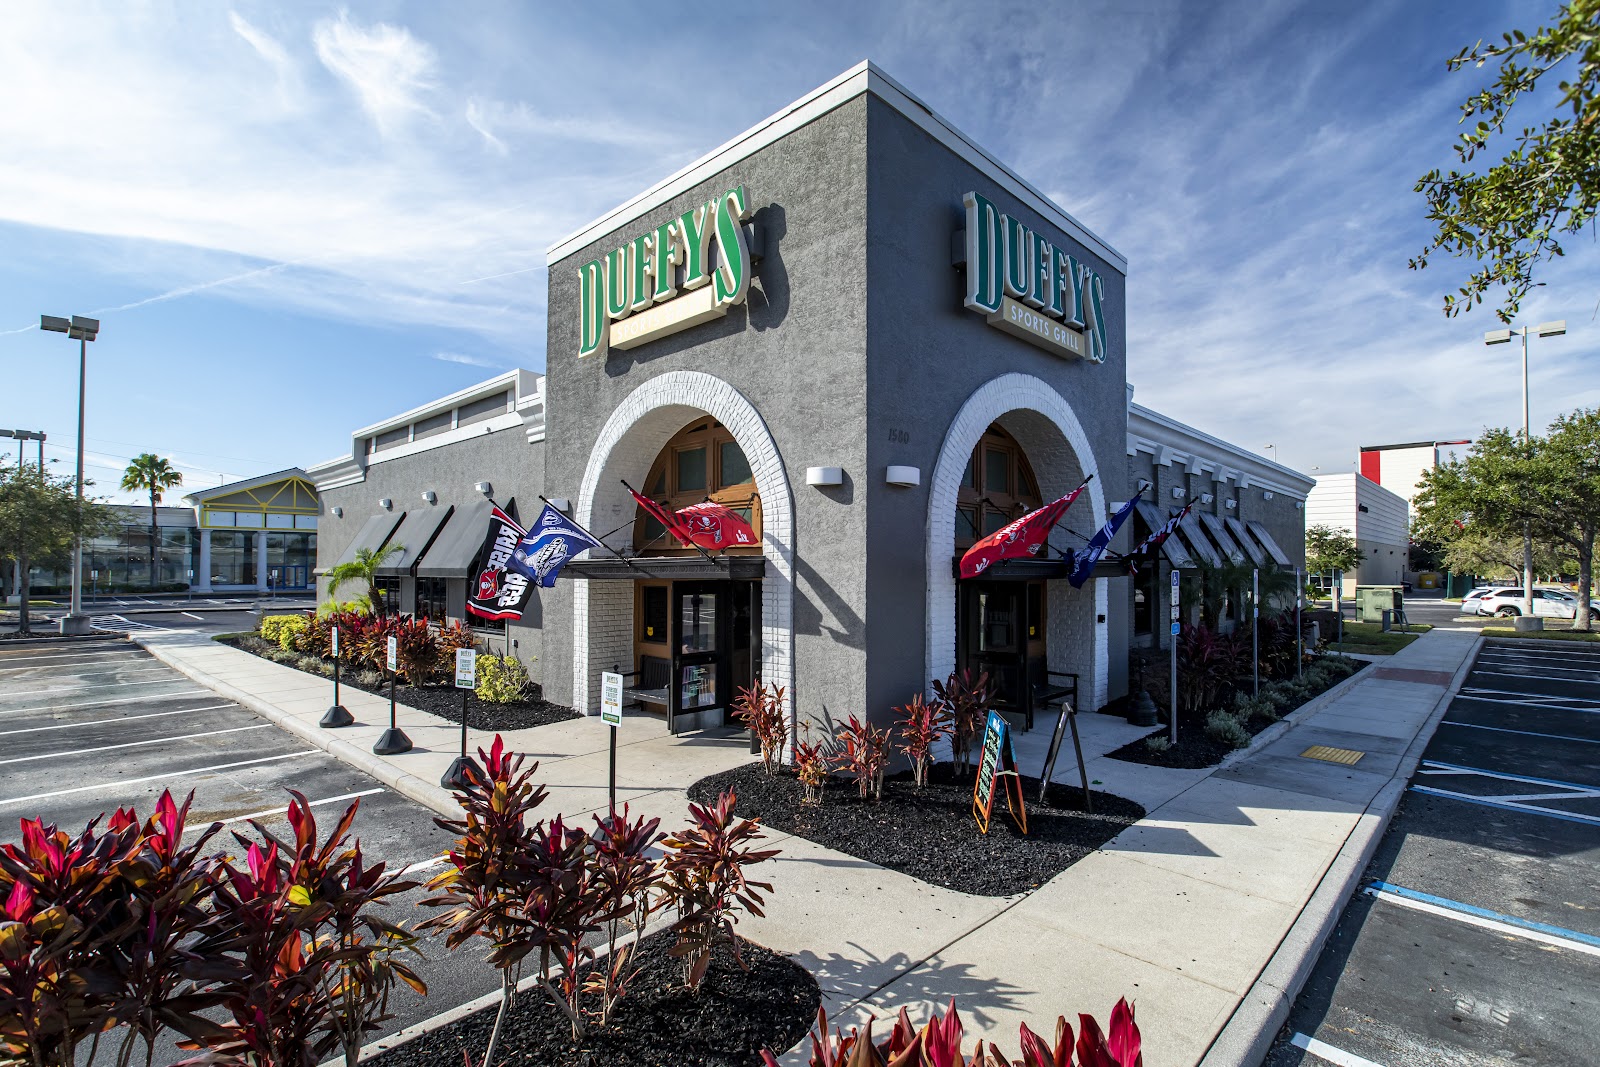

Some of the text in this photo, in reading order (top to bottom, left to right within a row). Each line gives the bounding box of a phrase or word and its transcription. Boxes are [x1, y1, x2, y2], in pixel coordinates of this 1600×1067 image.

[578, 184, 750, 358] DUFFY'S
[963, 191, 1107, 364] DUFFY'S
[617, 311, 660, 341] SPORTS
[1011, 305, 1079, 350] SPORTS GRILL
